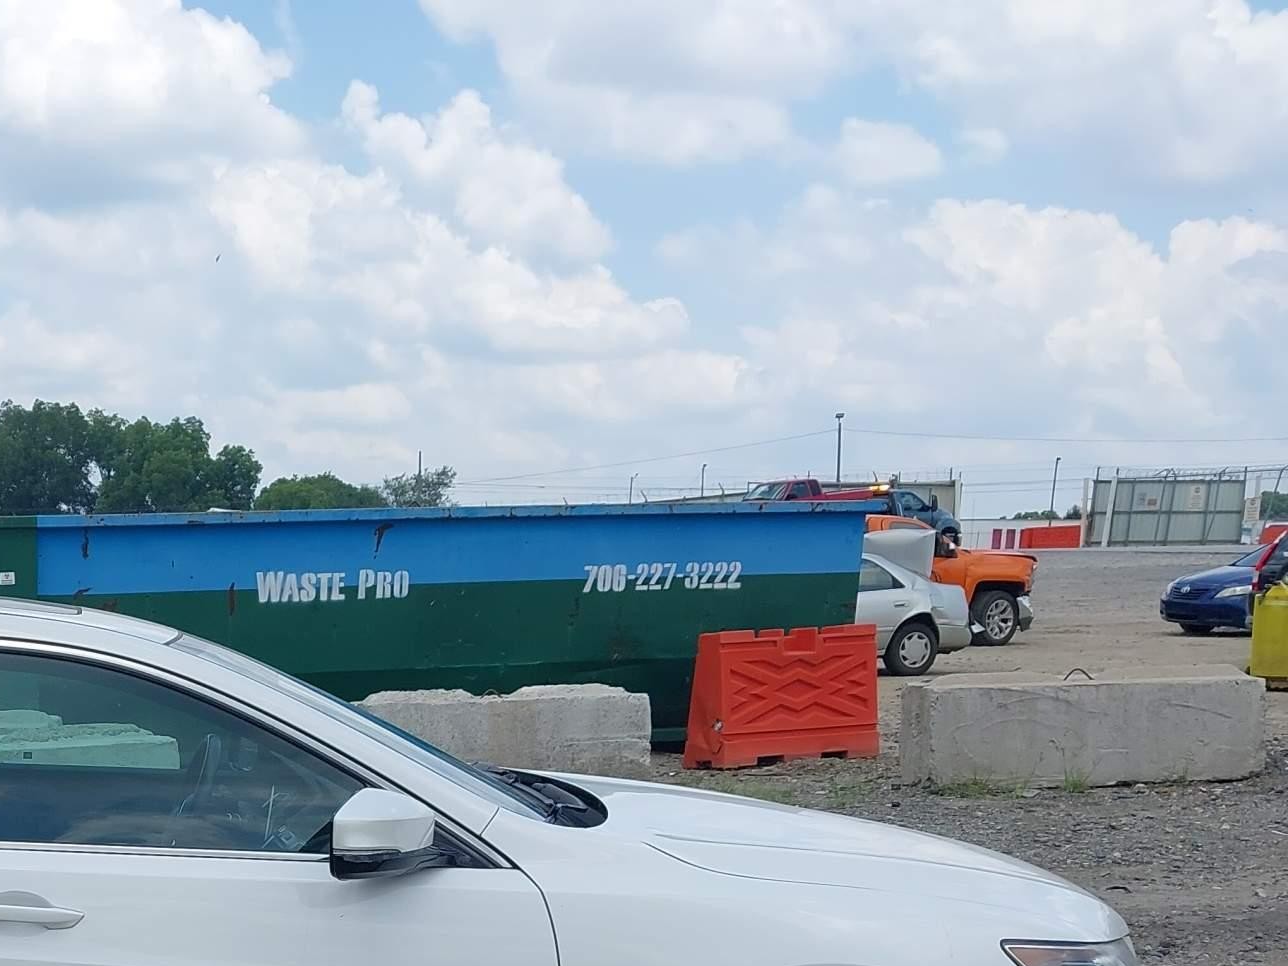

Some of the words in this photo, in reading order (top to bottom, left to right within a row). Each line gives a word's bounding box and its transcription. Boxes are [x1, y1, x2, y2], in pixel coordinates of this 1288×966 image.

[256, 571, 346, 603] WASTE
[357, 569, 410, 600] PRO
[582, 561, 742, 593] 706-227-3222
